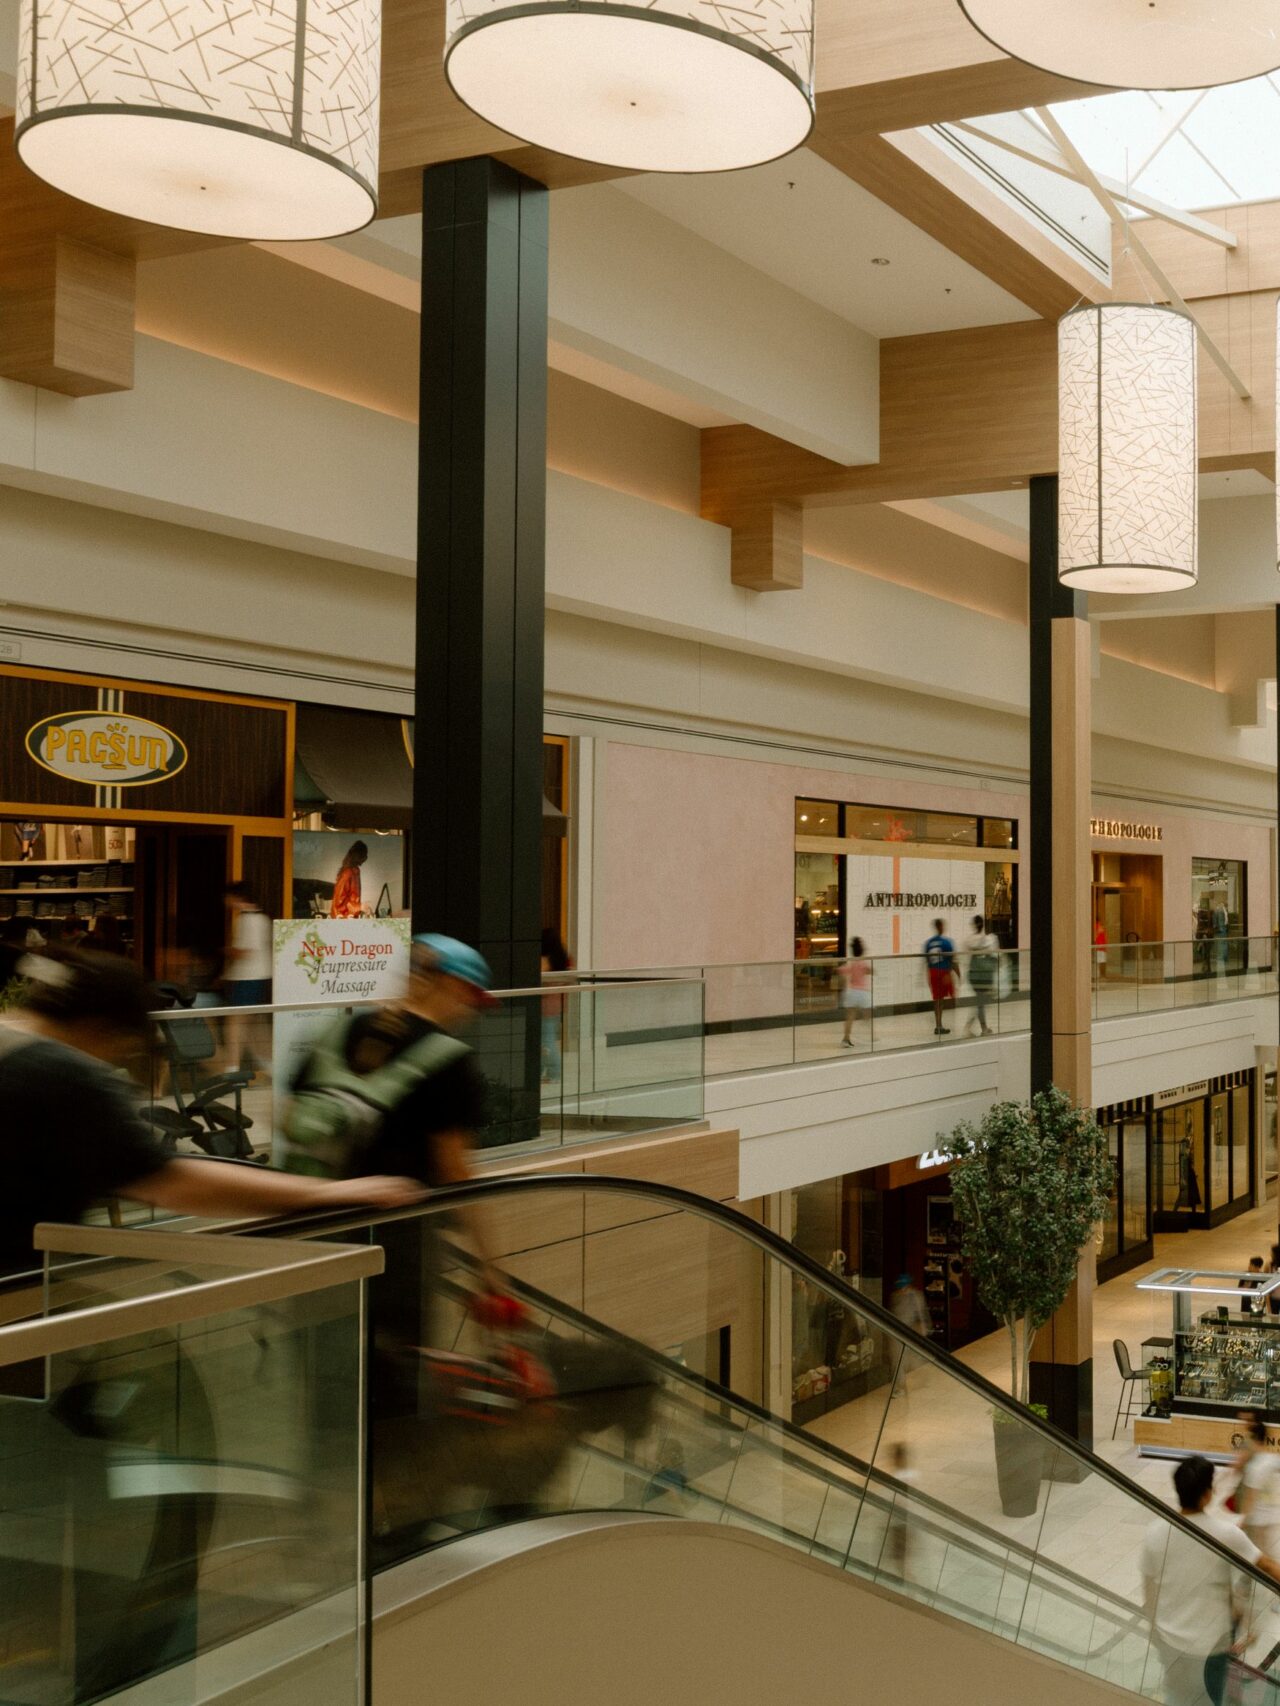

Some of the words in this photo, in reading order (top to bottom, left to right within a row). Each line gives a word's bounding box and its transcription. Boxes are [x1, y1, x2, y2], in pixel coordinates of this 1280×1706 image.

[46, 723, 168, 772] PACSUN
[1090, 820, 1163, 841] THROPOLOGIE
[864, 892, 977, 908] ANTHROPOLOGIE
[302, 941, 336, 957] New
[341, 940, 393, 960] Dragon
[305, 958, 388, 979] Acupressure
[321, 979, 377, 997] Massage
